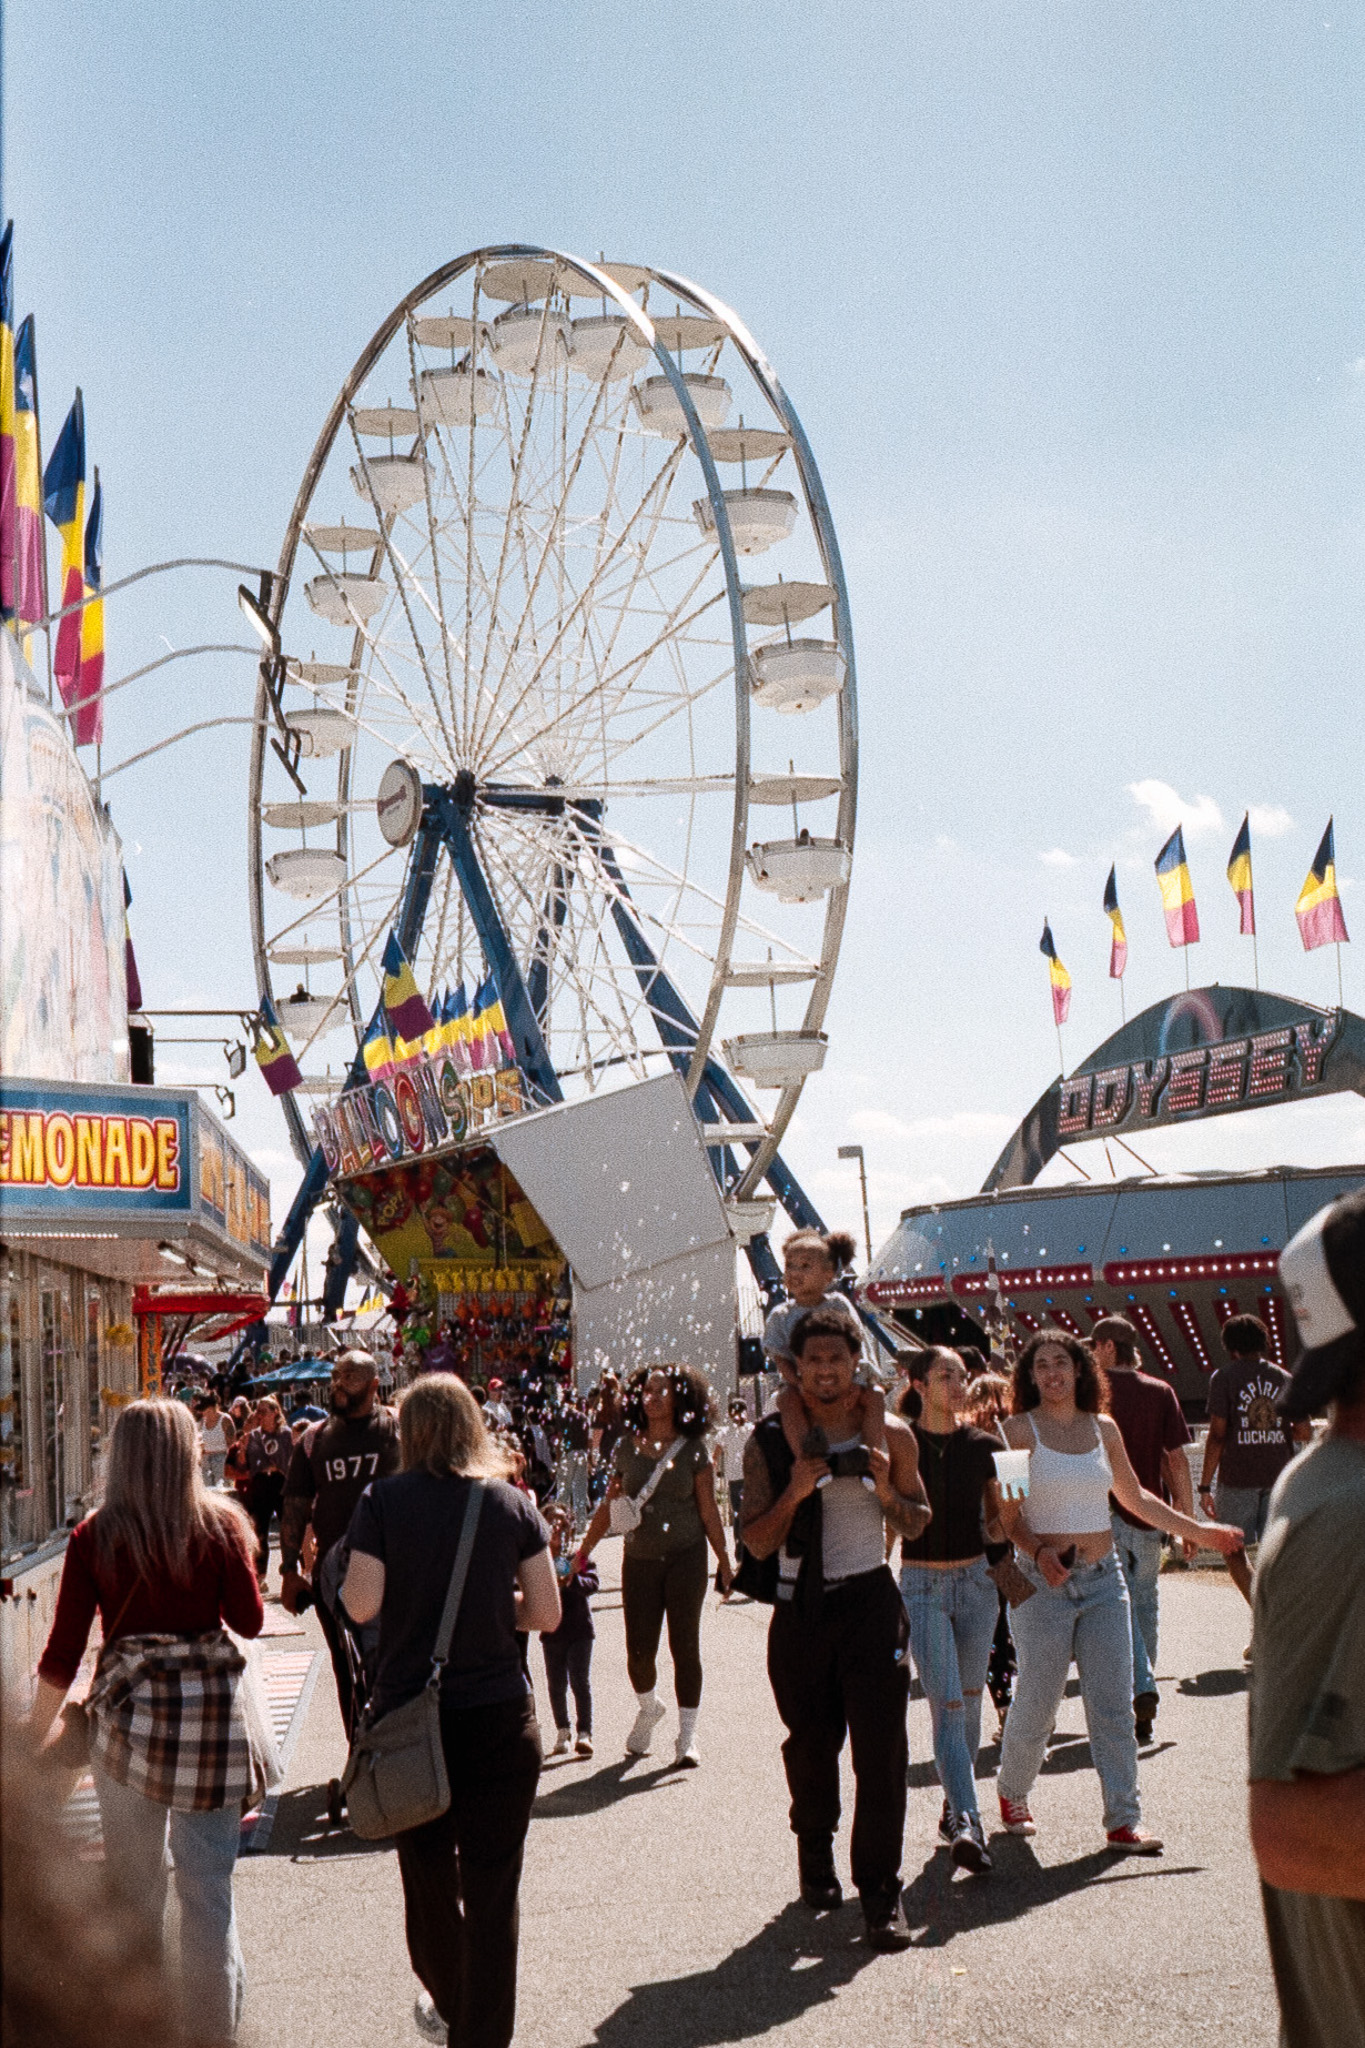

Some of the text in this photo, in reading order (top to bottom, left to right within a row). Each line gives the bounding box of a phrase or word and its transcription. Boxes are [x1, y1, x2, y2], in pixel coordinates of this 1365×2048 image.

[313, 1060, 469, 1179] BALLOONS
[1059, 1016, 1337, 1134] ODYSSEY
[325, 1453, 380, 1482] 1977
